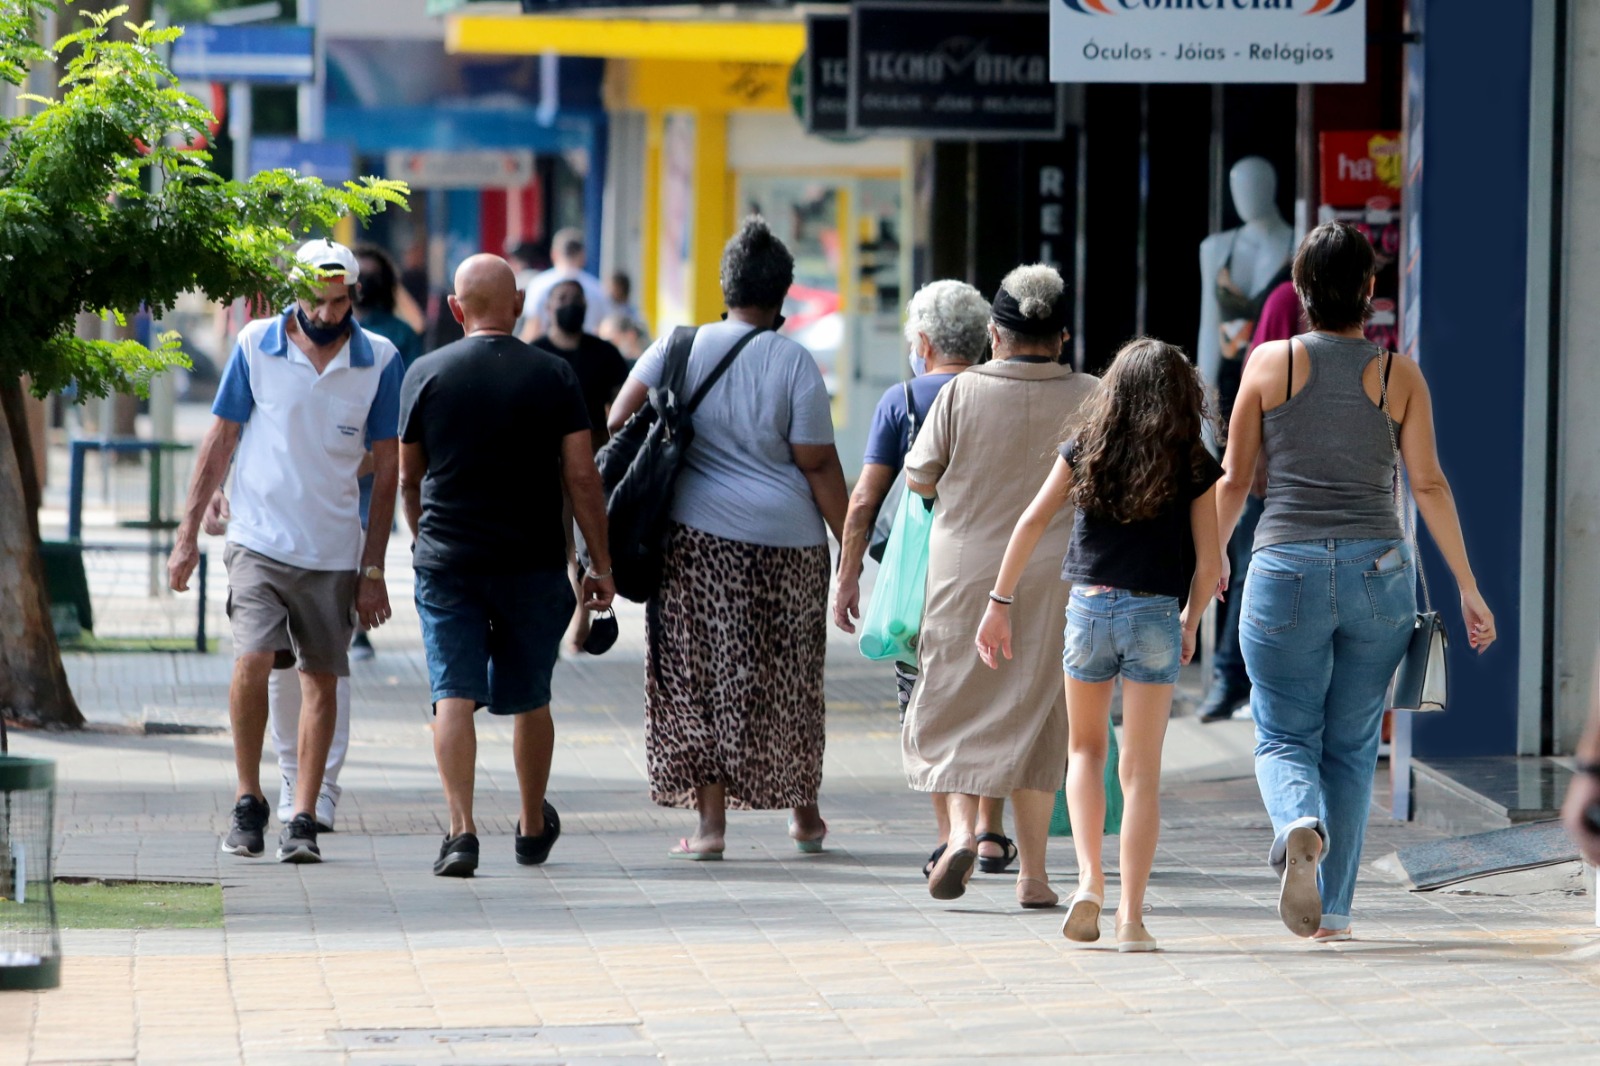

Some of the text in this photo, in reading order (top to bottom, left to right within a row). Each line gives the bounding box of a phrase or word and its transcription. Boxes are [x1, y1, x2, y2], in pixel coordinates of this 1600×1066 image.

[1083, 38, 1151, 60] Óculos
[1175, 42, 1226, 60] Jóias
[1249, 43, 1334, 65] Relógios
